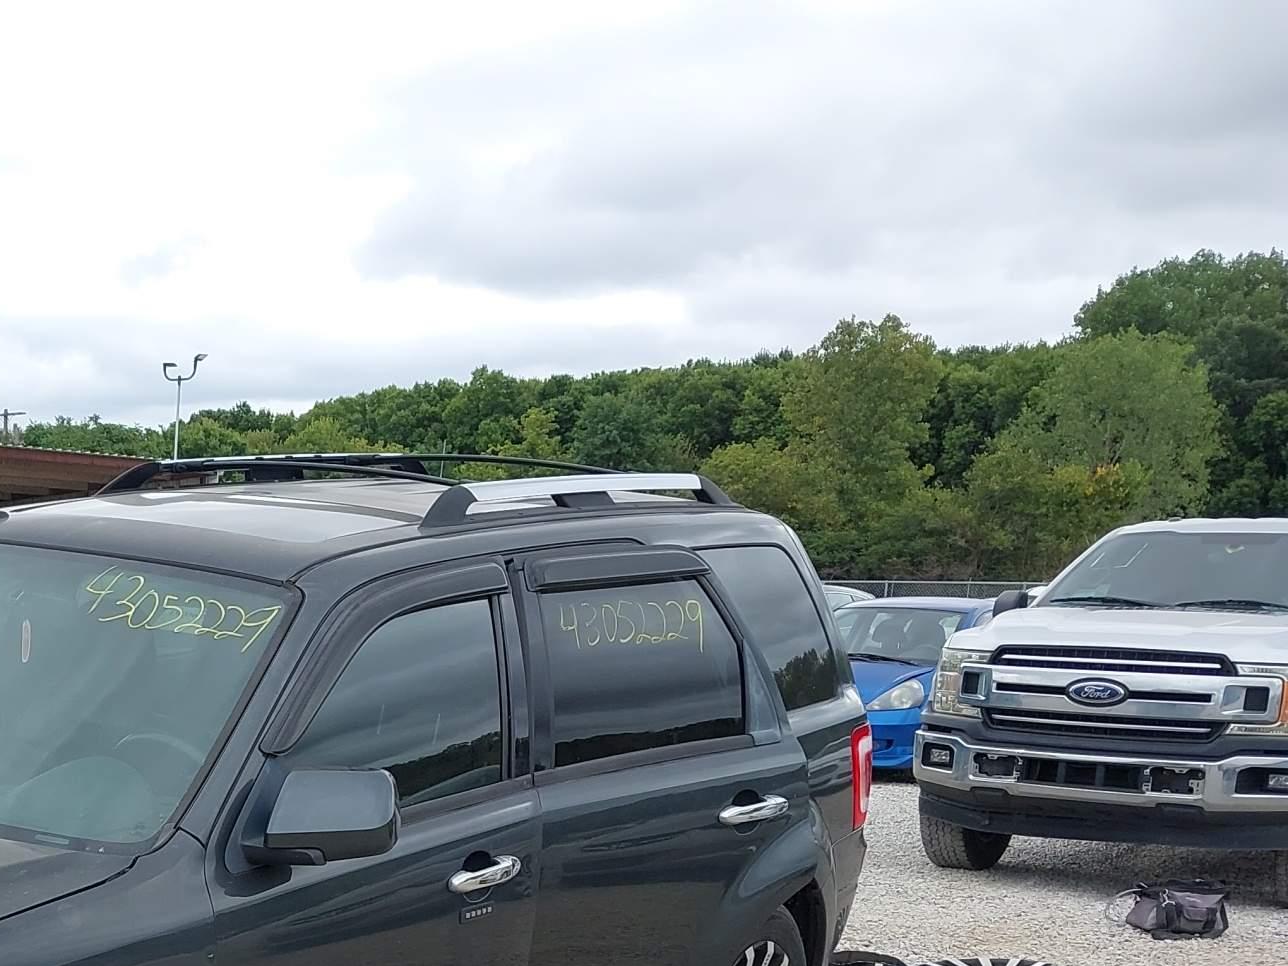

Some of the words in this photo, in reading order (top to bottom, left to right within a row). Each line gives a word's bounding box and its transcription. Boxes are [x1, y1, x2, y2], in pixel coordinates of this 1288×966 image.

[86, 565, 282, 653] 43052229
[560, 600, 703, 654] 43052229
[1080, 685, 1112, 699] Ford
